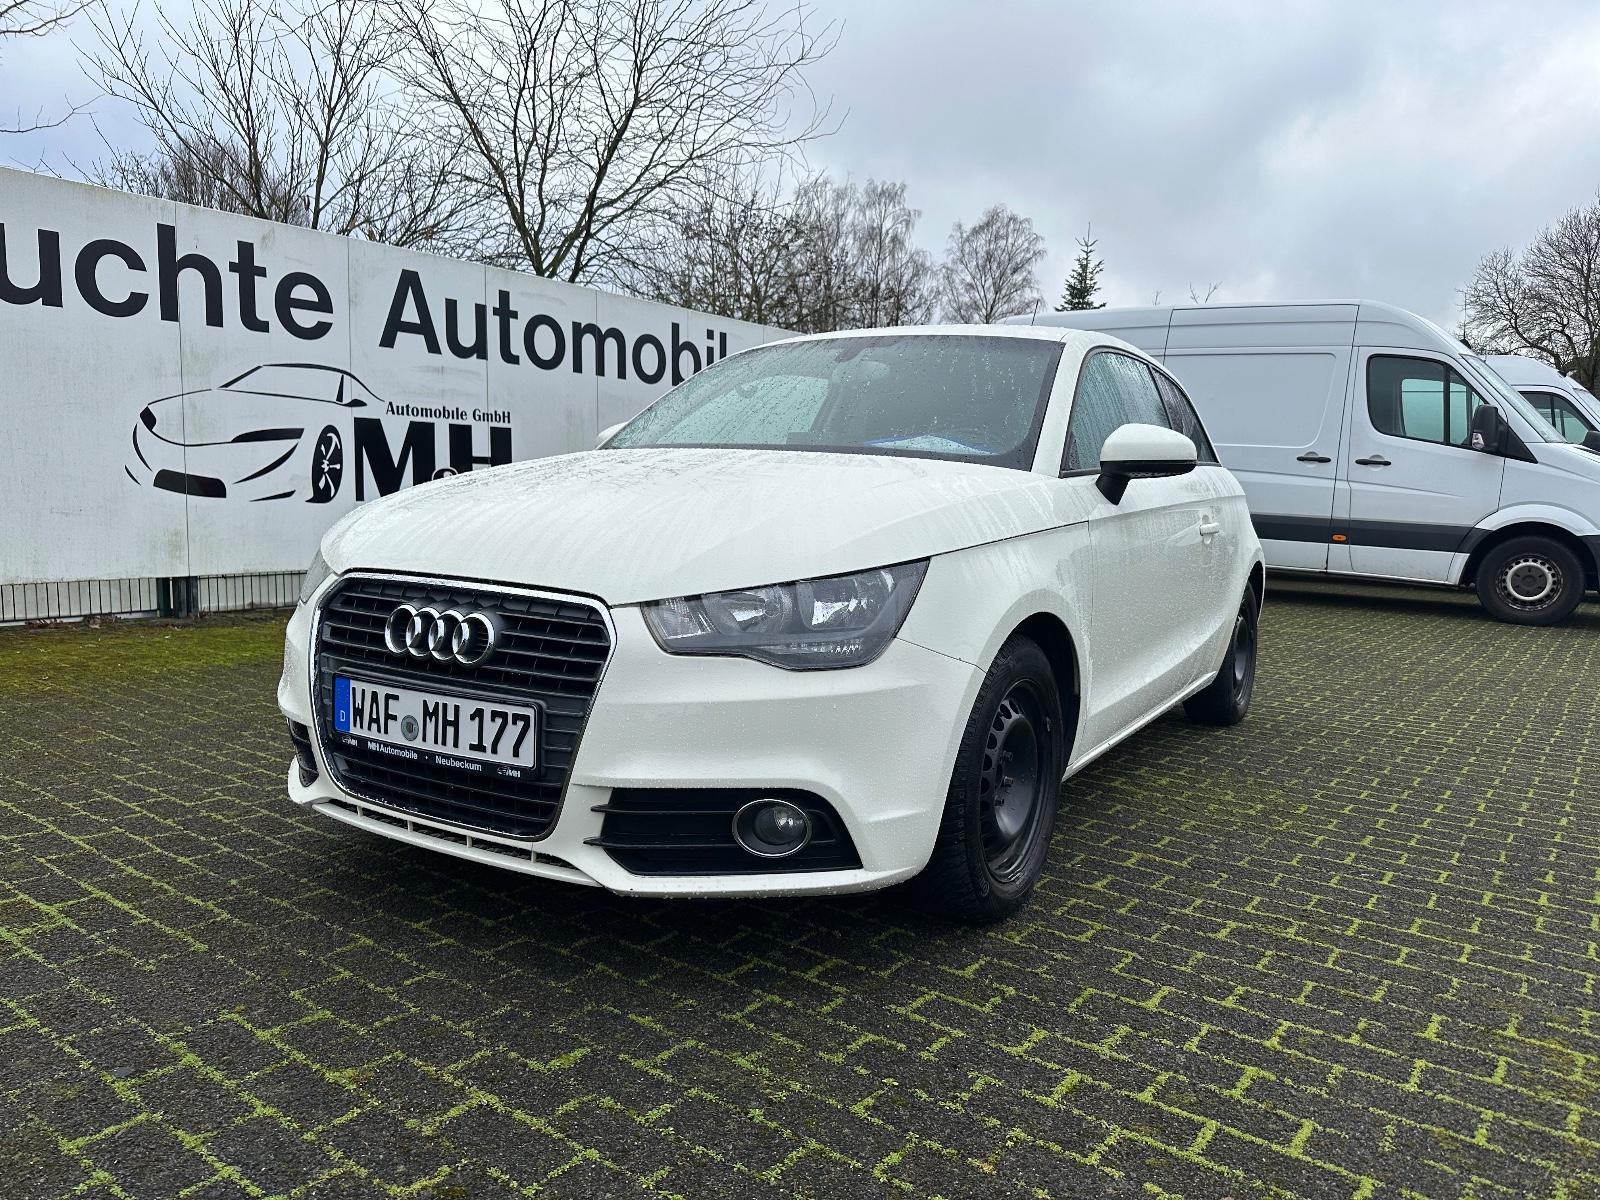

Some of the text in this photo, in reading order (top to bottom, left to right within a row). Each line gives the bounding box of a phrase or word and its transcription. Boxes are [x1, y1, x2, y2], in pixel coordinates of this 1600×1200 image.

[0, 223, 334, 340] uchte
[386, 401, 511, 424] Automobile GmbH
[340, 710, 346, 722] D
[351, 686, 531, 758] WAF MH 177
[367, 741, 482, 772] MH Automobile Neubeckum
